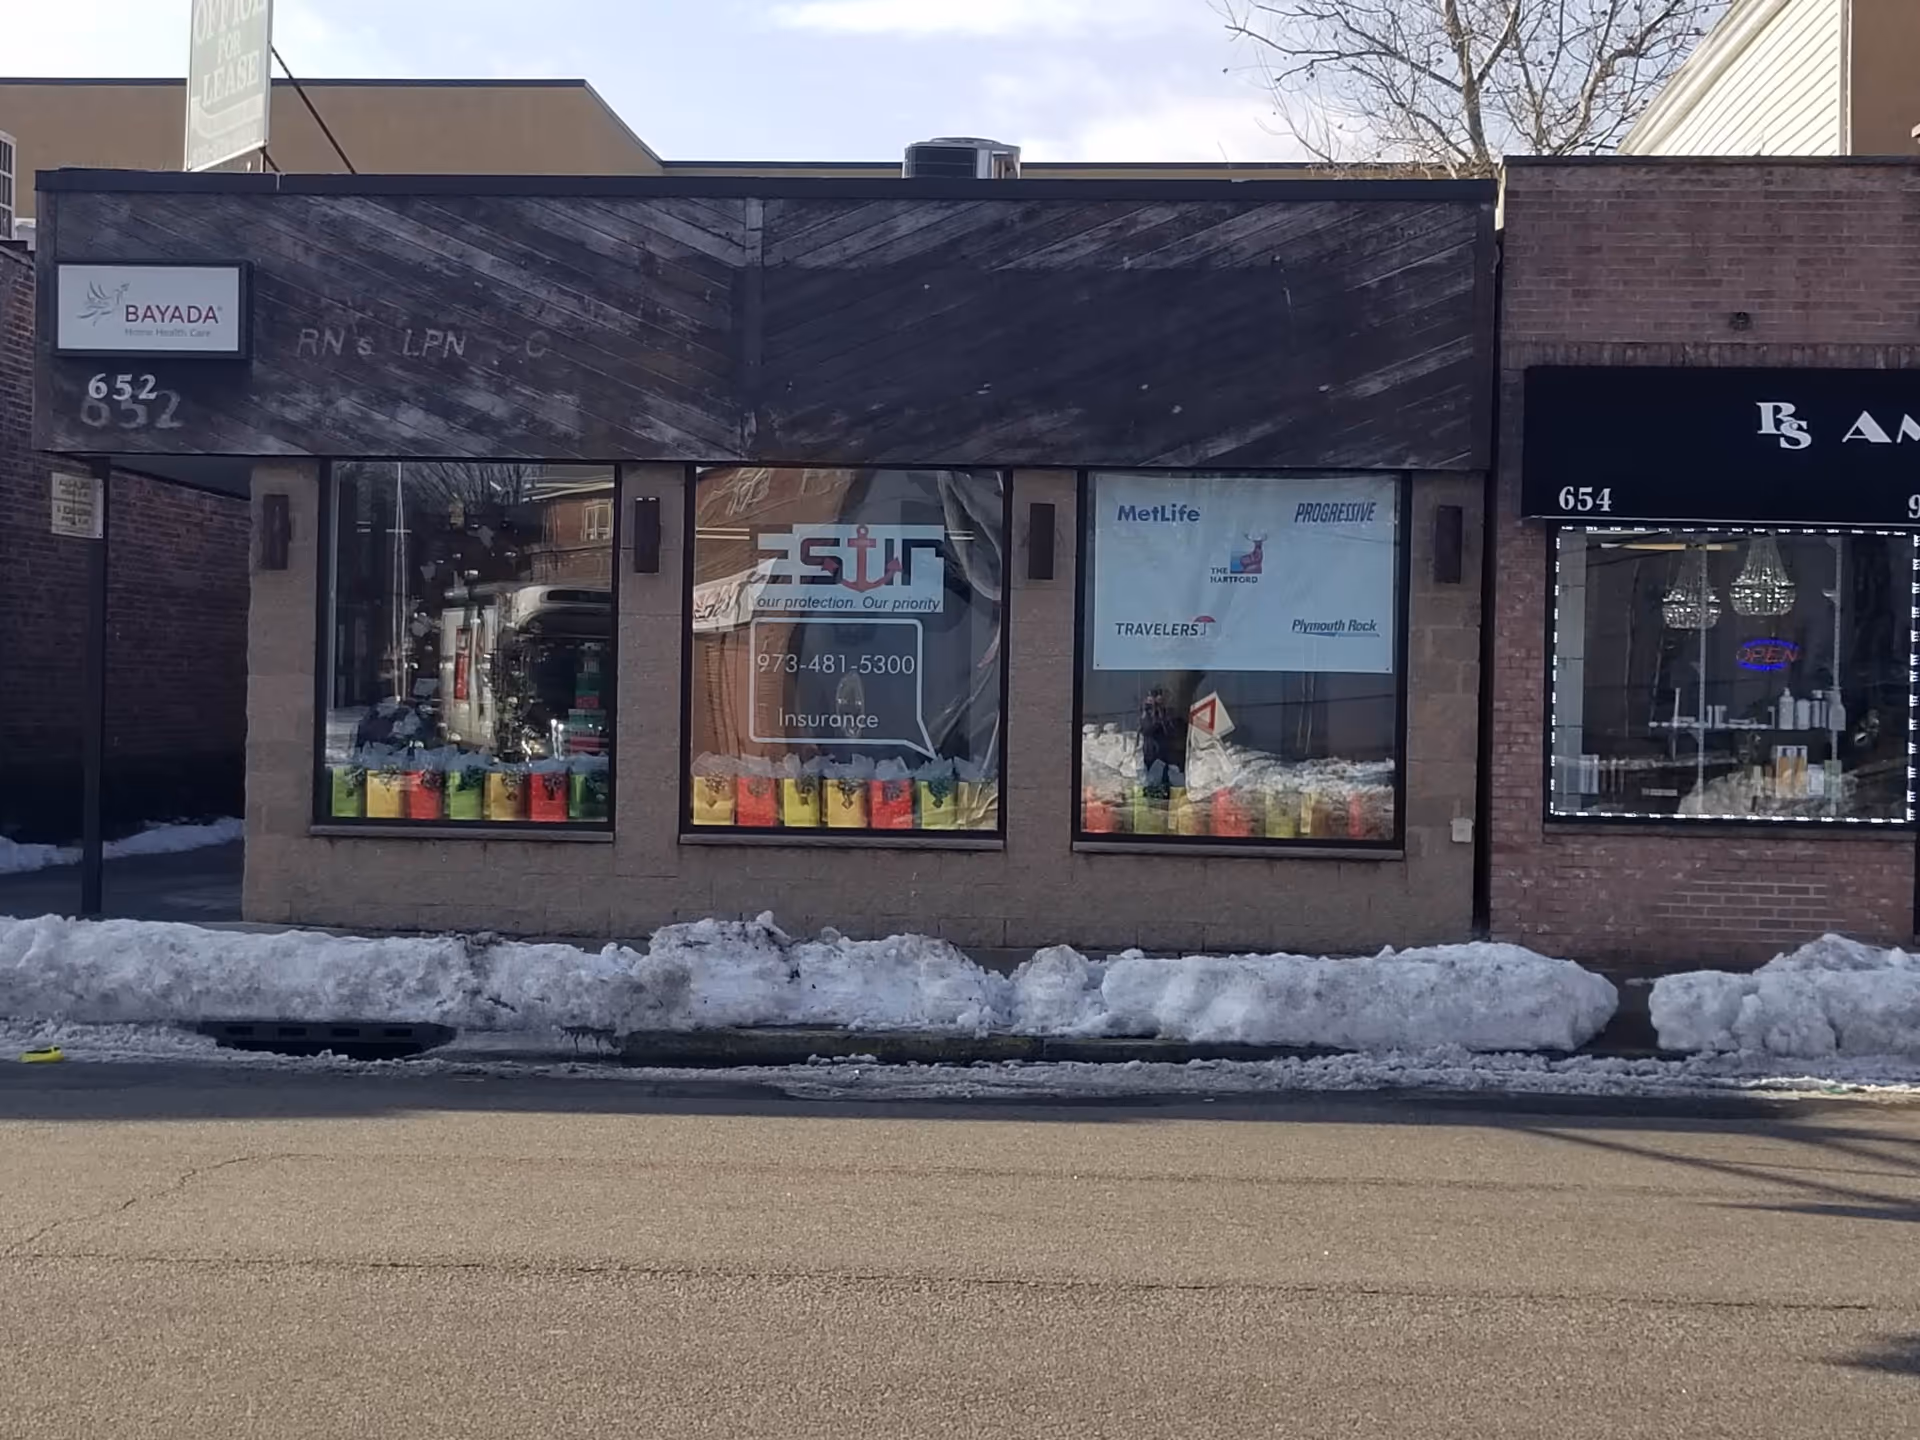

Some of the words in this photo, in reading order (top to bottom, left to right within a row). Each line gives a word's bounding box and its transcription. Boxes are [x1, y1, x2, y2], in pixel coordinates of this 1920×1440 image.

[217, 30, 242, 65] FOR
[202, 49, 260, 108] LEASE
[125, 304, 219, 325] BAYADA
[156, 328, 188, 338] Health
[190, 329, 212, 338] Care
[88, 373, 158, 401] 652
[1559, 486, 1612, 512] 654
[1117, 504, 1201, 523] MetLife
[1294, 502, 1377, 523] PROGRESSIVE
[1209, 576, 1259, 584] HARTFORD
[1210, 567, 1229, 575] THE
[784, 596, 857, 610] protection.
[862, 596, 889, 609] Our
[892, 597, 941, 612] priority
[1115, 623, 1199, 636] TRAVELERS
[1291, 619, 1346, 634] Plymouth
[1347, 619, 1378, 632] Rock
[757, 653, 915, 674] 973-481-5300
[1735, 647, 1799, 663] OPEN
[778, 707, 880, 727] Insurance
